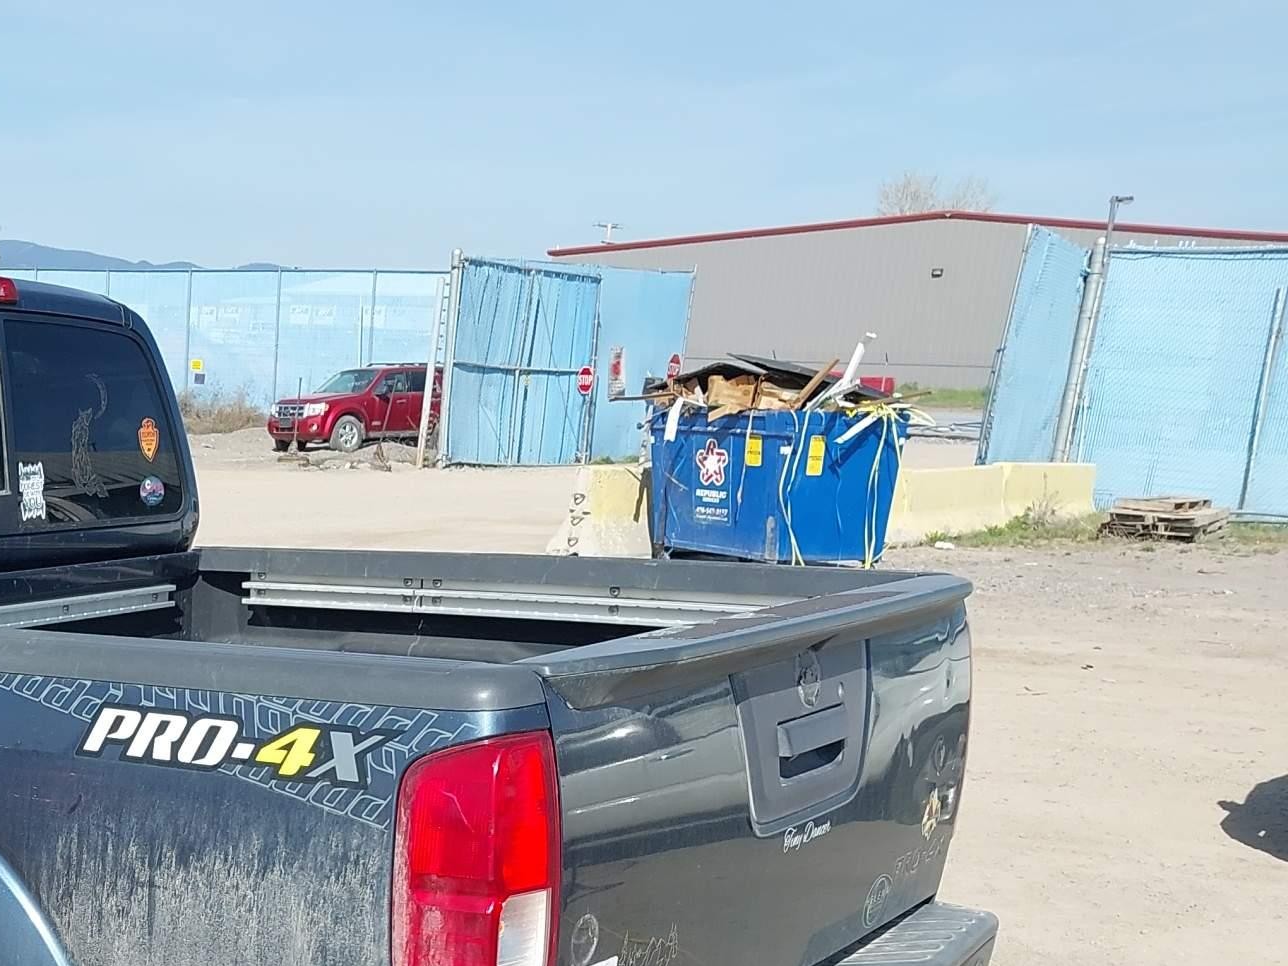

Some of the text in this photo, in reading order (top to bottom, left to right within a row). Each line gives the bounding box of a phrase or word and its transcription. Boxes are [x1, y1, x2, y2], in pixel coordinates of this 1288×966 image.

[578, 374, 593, 386] STOP
[695, 488, 728, 499] REPUBLIC
[82, 707, 387, 783] PRO-4X
